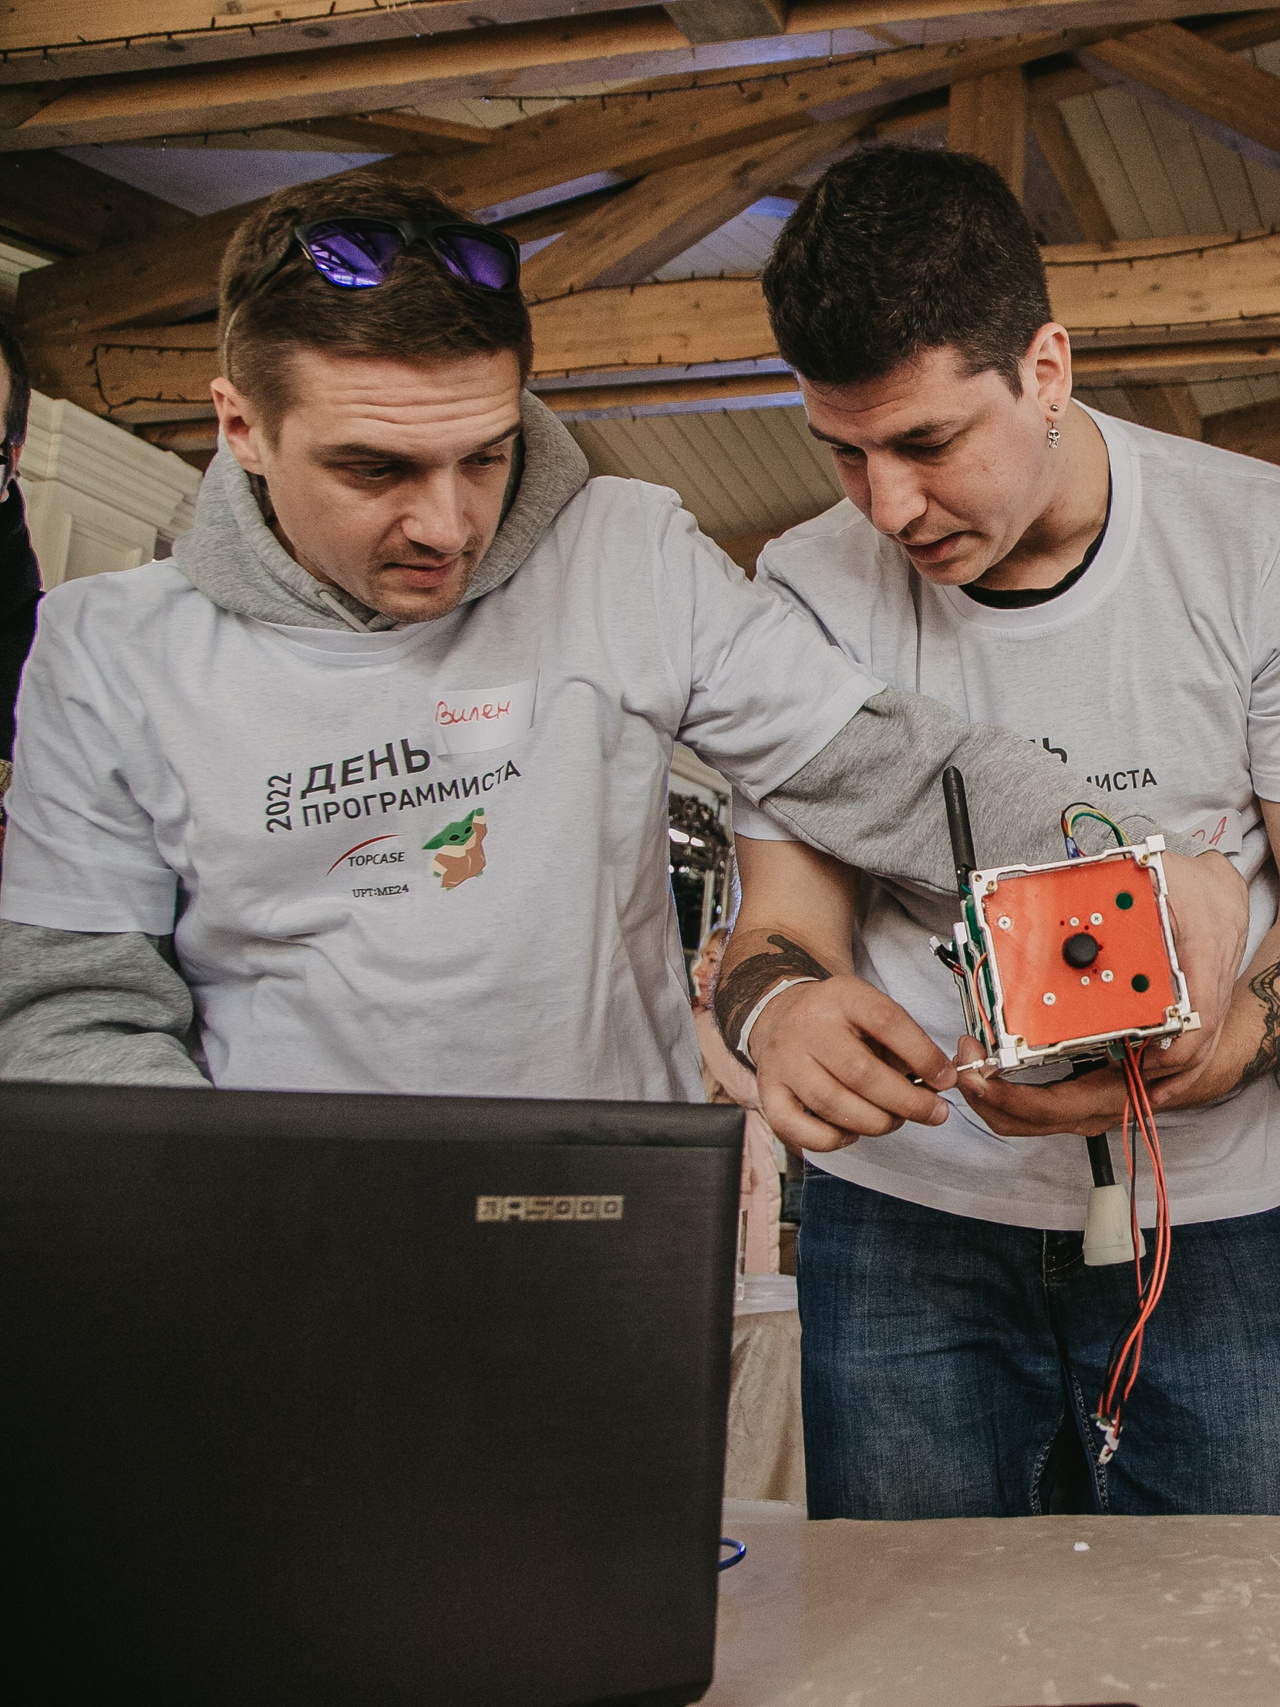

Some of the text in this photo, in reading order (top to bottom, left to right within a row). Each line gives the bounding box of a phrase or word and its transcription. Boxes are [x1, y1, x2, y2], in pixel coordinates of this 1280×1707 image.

[434, 700, 512, 725] Вилен
[300, 738, 432, 800] ДЕНЬ
[266, 772, 293, 834] 2022
[302, 760, 522, 827] ПРОГРАММИСТА
[347, 851, 405, 867] TOPCASE
[352, 884, 409, 898] UPT:ME24
